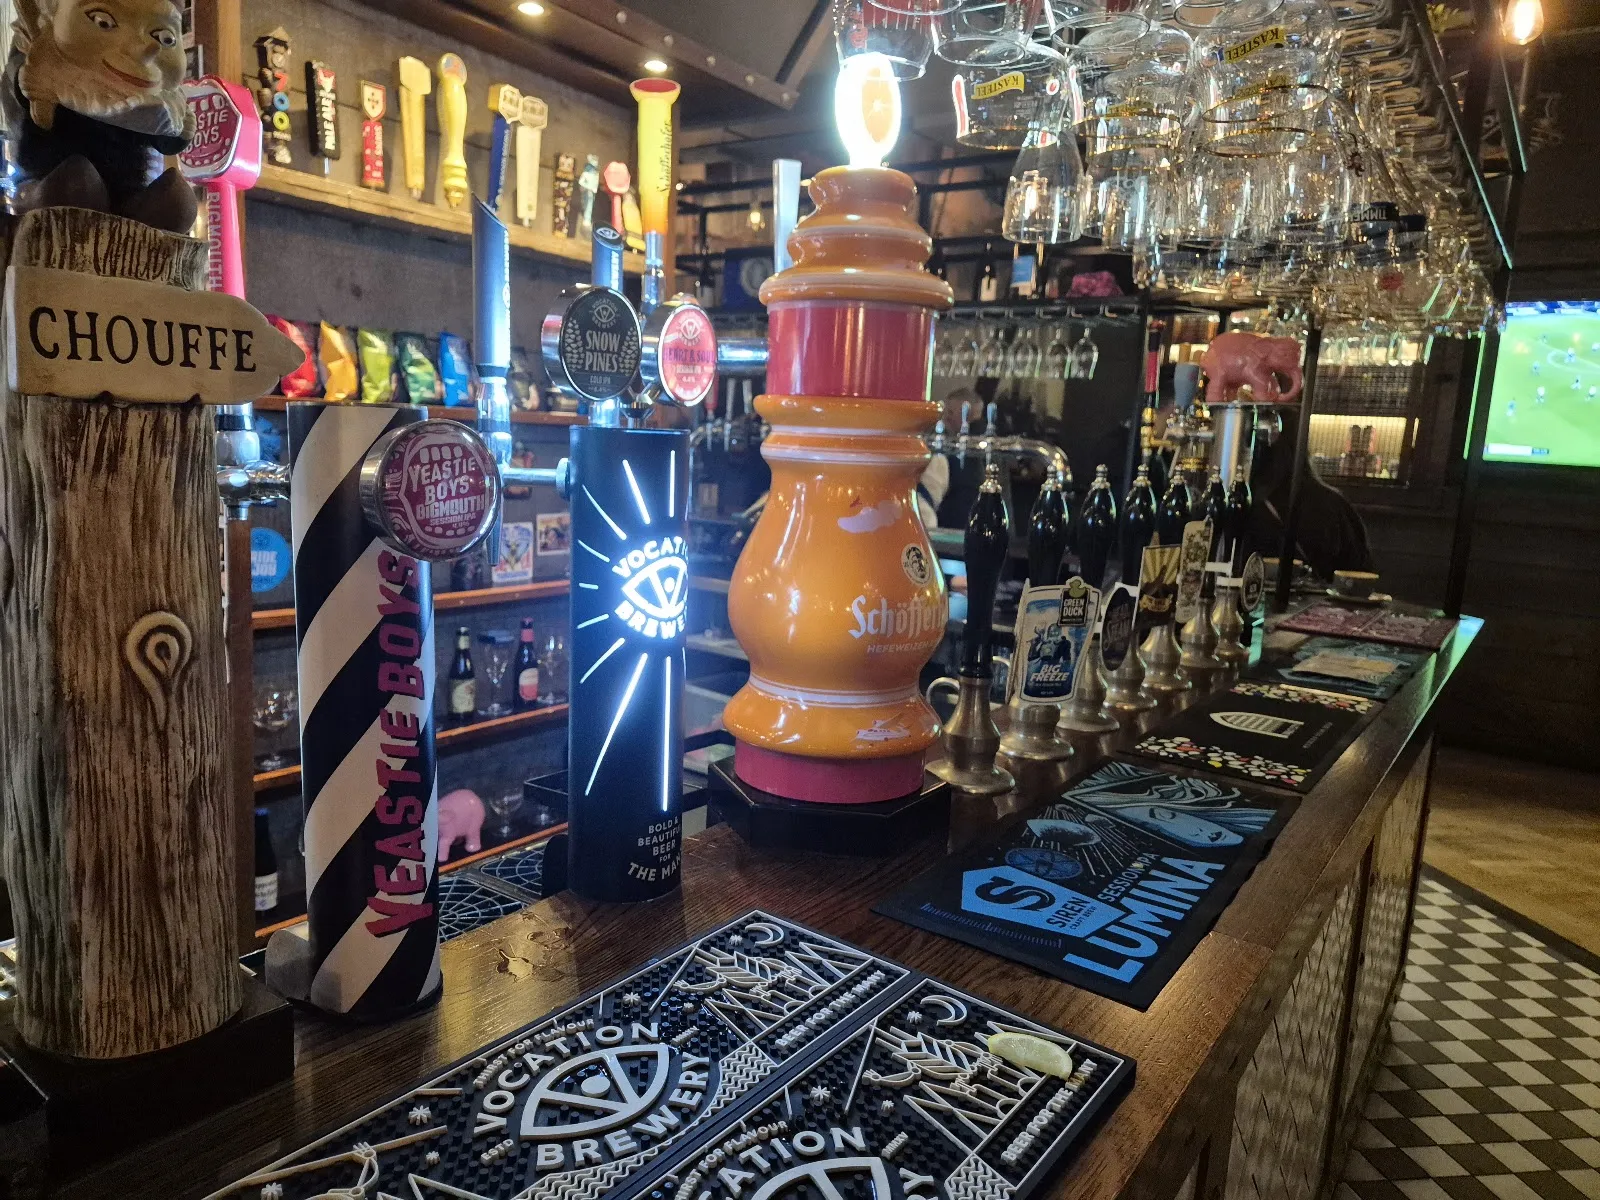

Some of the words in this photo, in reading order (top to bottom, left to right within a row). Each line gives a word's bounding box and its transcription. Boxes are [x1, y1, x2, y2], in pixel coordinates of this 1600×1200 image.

[1224, 28, 1279, 60] KASTEEL
[976, 75, 1019, 96] KASTEEL
[197, 109, 229, 130] STIE
[207, 191, 223, 289] BIGMOUTH
[28, 305, 258, 373] CHOUFFE
[585, 330, 621, 352] SNOW
[584, 352, 619, 373] PINES
[408, 457, 476, 494] YEASTIE
[424, 475, 471, 506] BOYS
[415, 493, 487, 521] BIGMOUTH
[429, 514, 464, 526] SESSION
[464, 512, 477, 521] IPA
[611, 535, 689, 578] VOCATI
[1062, 606, 1084, 617] DUCK
[1063, 598, 1085, 607] GREEN
[377, 548, 426, 702] BOYS
[614, 599, 688, 640] BREWE
[1030, 672, 1070, 682] FREEZE
[1040, 664, 1062, 674] BIG
[364, 708, 435, 938] YEASTIE
[637, 823, 681, 847] BEAUTIFU
[648, 819, 673, 835] BOLD
[652, 839, 676, 857] BEER
[659, 853, 671, 863] FOR
[627, 861, 657, 881] THE
[661, 852, 681, 880] MAN
[1097, 864, 1145, 903] SESSION
[1046, 896, 1092, 929] SIREN
[1063, 857, 1226, 983] LUMINA
[1069, 915, 1085, 931] CRAFT
[774, 1023, 810, 1049] BEER
[804, 1007, 834, 1030] FOR
[828, 991, 858, 1013] THE
[850, 969, 886, 998] MANY
[473, 1053, 509, 1090] THIRST
[507, 1037, 534, 1060] FOR
[533, 1018, 596, 1045] FLAVOUR
[472, 1022, 660, 1137] VOCATION
[535, 1051, 710, 1172] BREWERY
[1000, 1131, 1036, 1166] BEER
[1026, 1108, 1056, 1137] FOR
[1045, 1086, 1075, 1114] THE
[1064, 1058, 1098, 1093] MANY
[480, 1138, 515, 1166] ESTD
[698, 1147, 726, 1175] FOR
[723, 1120, 790, 1156] FLAVOUR
[881, 1131, 910, 1160] MMXV
[698, 1126, 867, 1200] ATION
